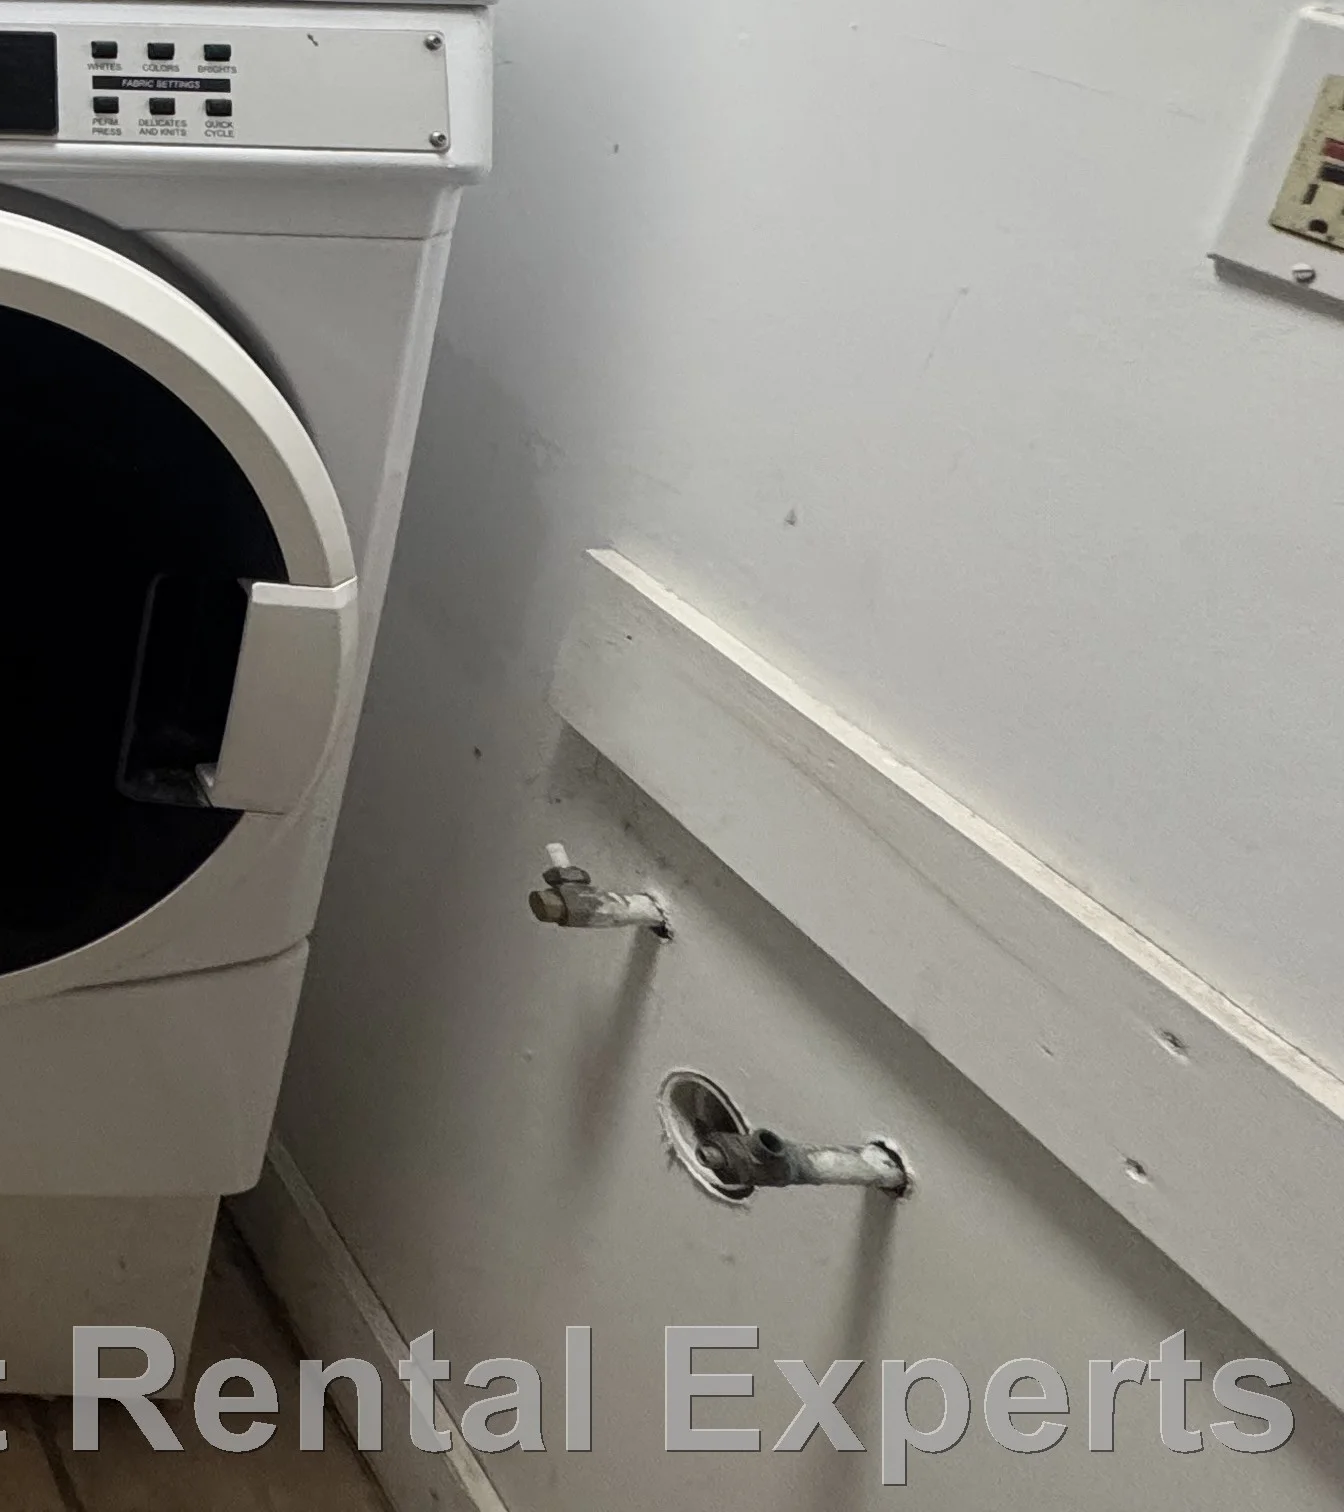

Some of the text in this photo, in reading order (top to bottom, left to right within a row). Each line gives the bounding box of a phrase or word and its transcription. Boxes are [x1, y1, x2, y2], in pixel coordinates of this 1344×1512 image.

[87, 63, 122, 71] WHITES
[142, 64, 180, 72] COLORS
[198, 65, 237, 74] BRIGHTS
[122, 79, 201, 89] FABRIC SETTINGS
[139, 119, 188, 128] DELICATES
[205, 120, 233, 129] QUICK
[92, 128, 122, 136] PRESS
[139, 128, 187, 136] AND KNITS
[204, 129, 235, 138] CYCLE
